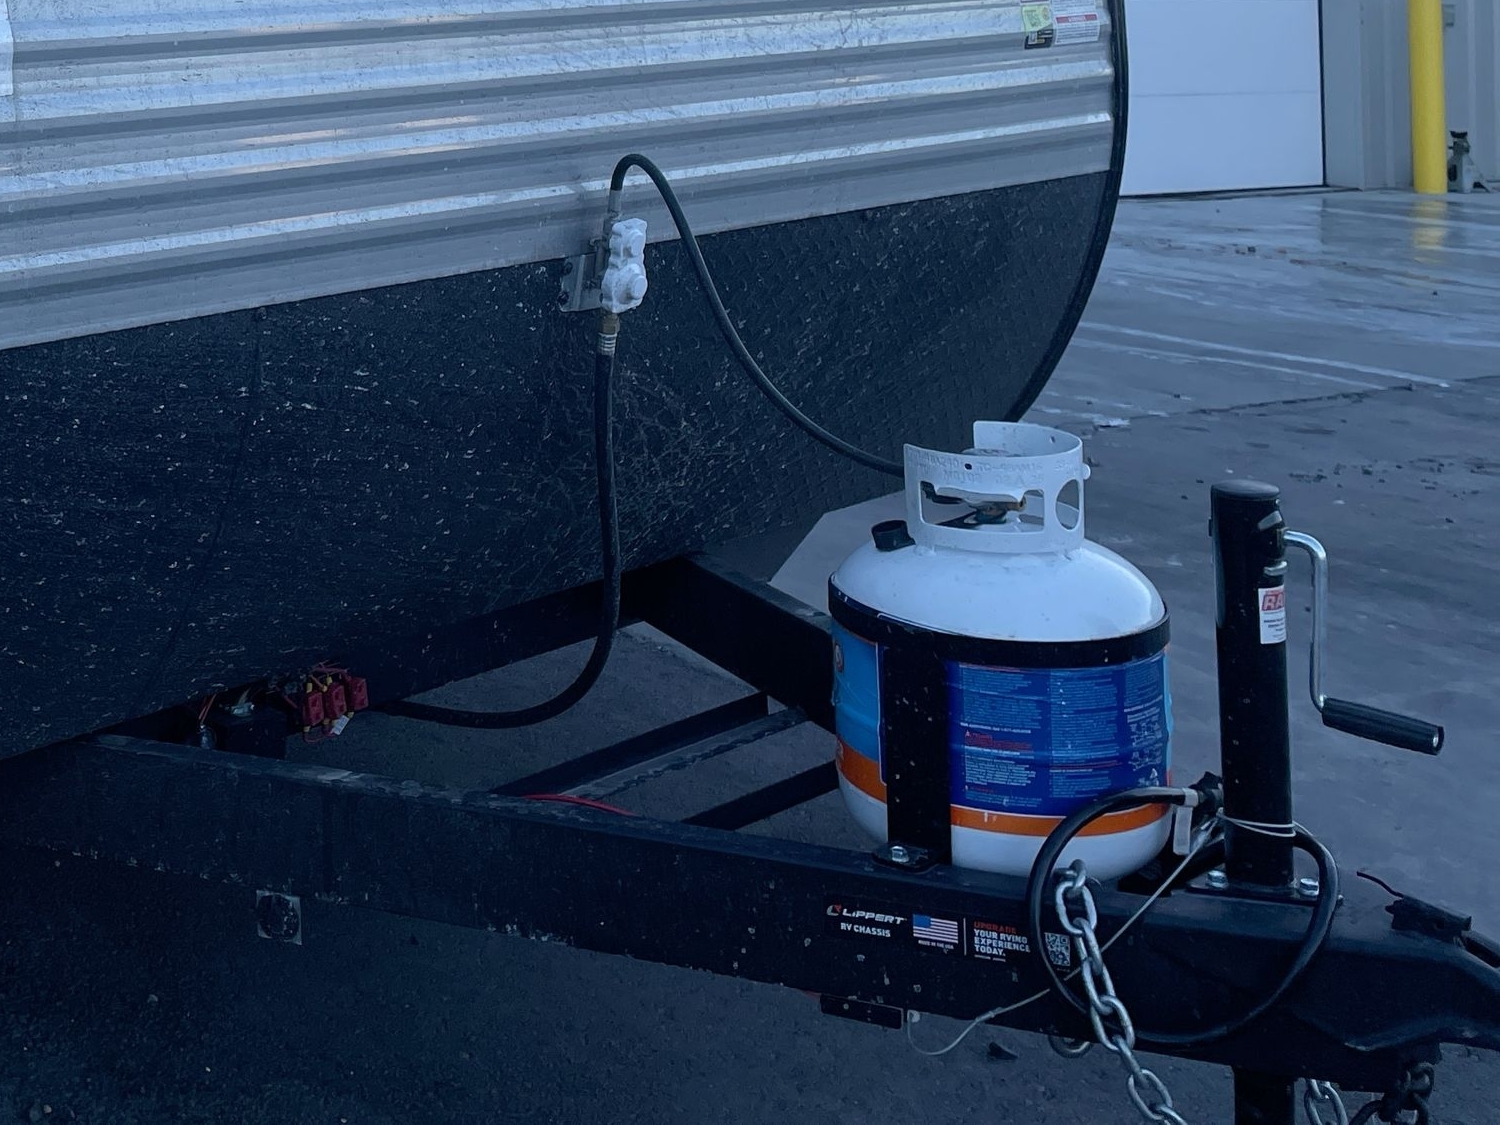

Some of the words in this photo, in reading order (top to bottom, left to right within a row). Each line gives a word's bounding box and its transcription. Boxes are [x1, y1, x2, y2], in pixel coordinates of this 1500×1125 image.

[1261, 593, 1285, 611] RA
[840, 922, 852, 931] RV
[854, 925, 891, 937] CHASSIS
[973, 921, 1017, 934] UPGRADE
[973, 928, 999, 940] YOUR
[1000, 932, 1028, 944] RVING
[973, 936, 1031, 953] EXPERIENCE
[974, 945, 1006, 956] TODAY.
